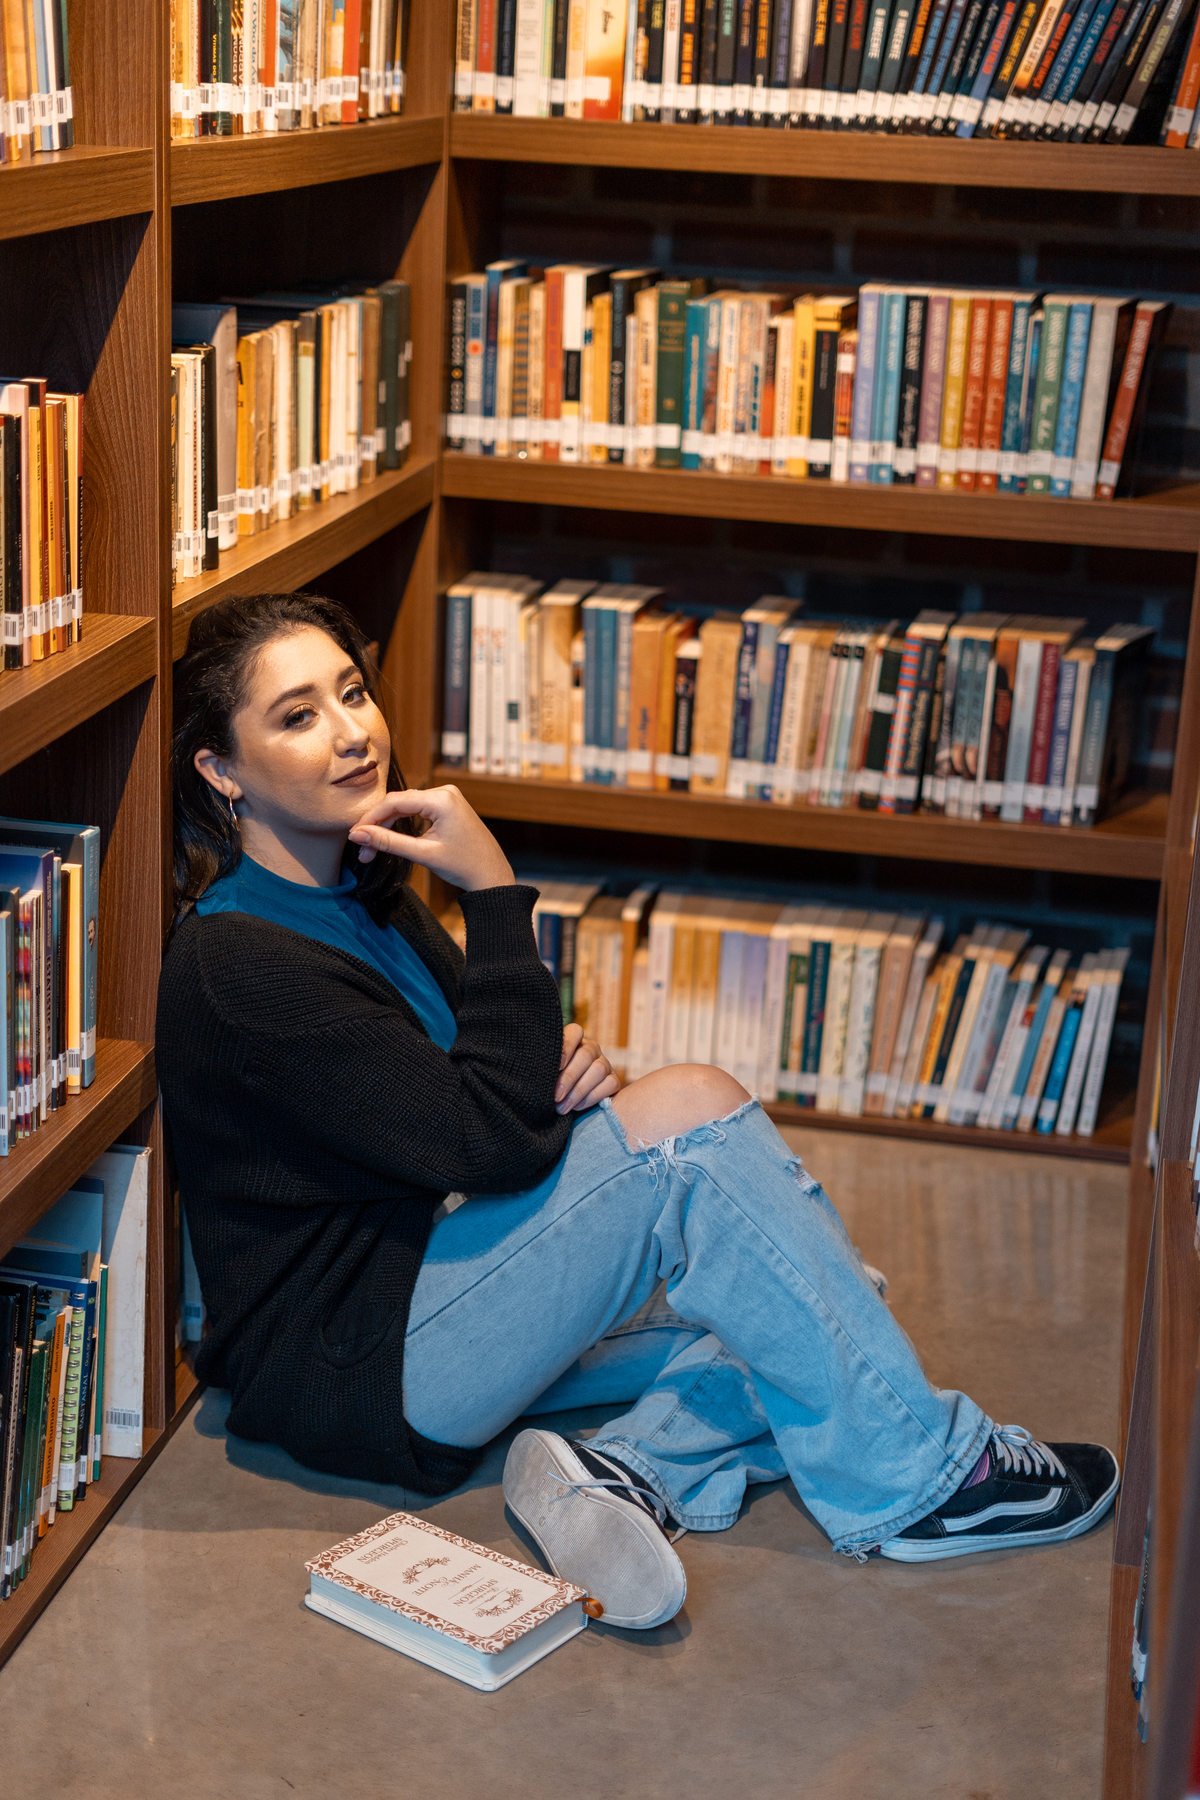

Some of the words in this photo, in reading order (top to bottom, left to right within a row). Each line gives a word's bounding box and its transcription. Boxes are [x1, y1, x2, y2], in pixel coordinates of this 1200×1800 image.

[874, 7, 886, 16] O
[897, 9, 909, 18] O
[1038, 5, 1056, 36] QUANDO
[1072, 10, 1088, 34] SEIS
[1089, 12, 1105, 36] SEIS
[867, 16, 885, 59] INOCENTE
[889, 17, 907, 60] INOCENTE
[1059, 34, 1078, 64] ANOS
[1076, 35, 1095, 65] ANOS
[1043, 64, 1065, 101] DEPOIS
[1059, 65, 1081, 102] DEPOIS
[79, 1372, 88, 1429] PANTANAL
[47, 1398, 56, 1442] humano
[357, 1537, 402, 1561] SPURGEON
[360, 1550, 388, 1564] Haddon
[387, 1540, 408, 1552] Charles
[412, 1578, 441, 1596] NOITE
[453, 1578, 498, 1606] SPURGEON
